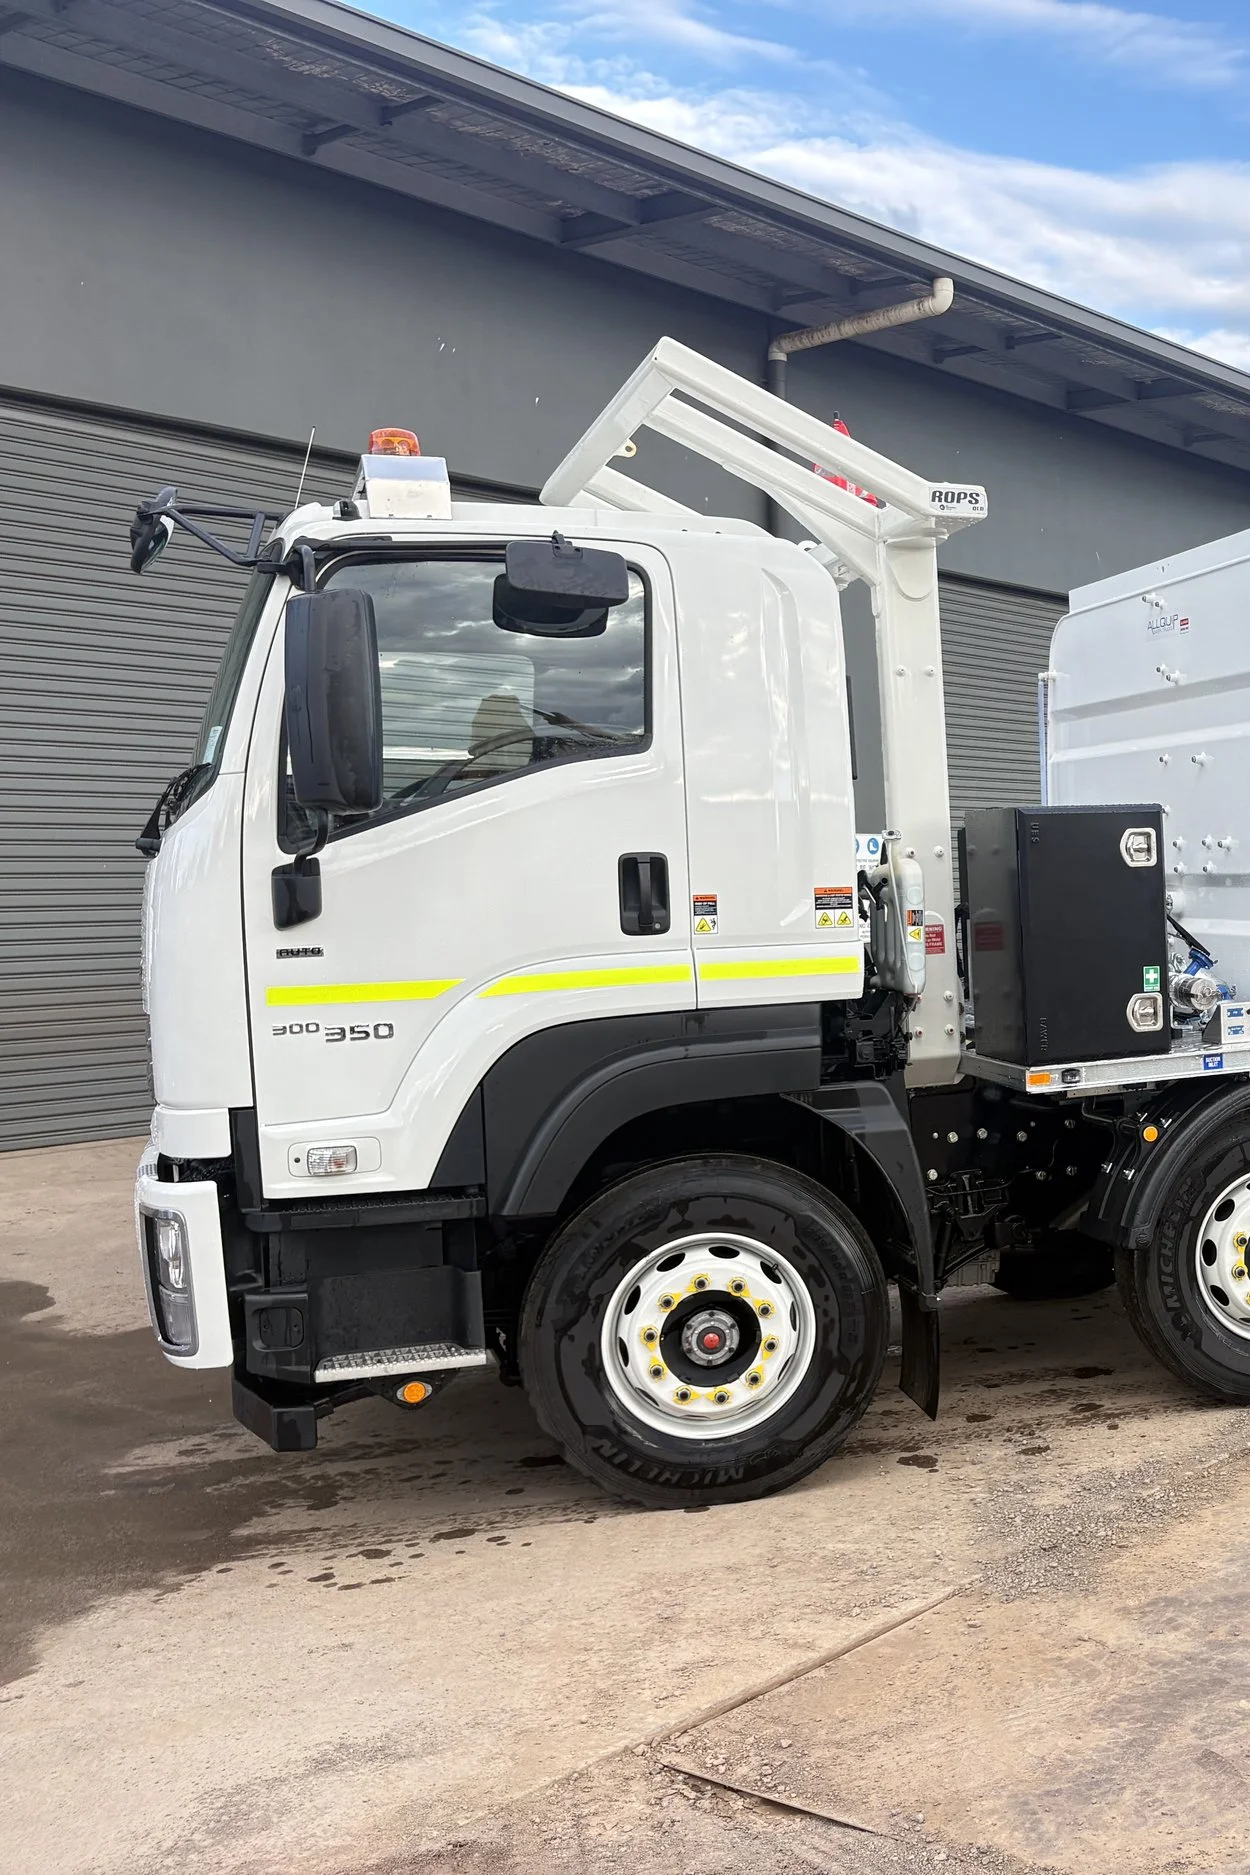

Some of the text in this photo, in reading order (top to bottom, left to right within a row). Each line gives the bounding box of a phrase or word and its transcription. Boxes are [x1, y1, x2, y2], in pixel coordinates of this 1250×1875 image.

[931, 490, 980, 505] ROPS
[1147, 613, 1179, 635] ALLQUIP
[279, 947, 322, 957] AUTO
[272, 1022, 395, 1043] 300 350
